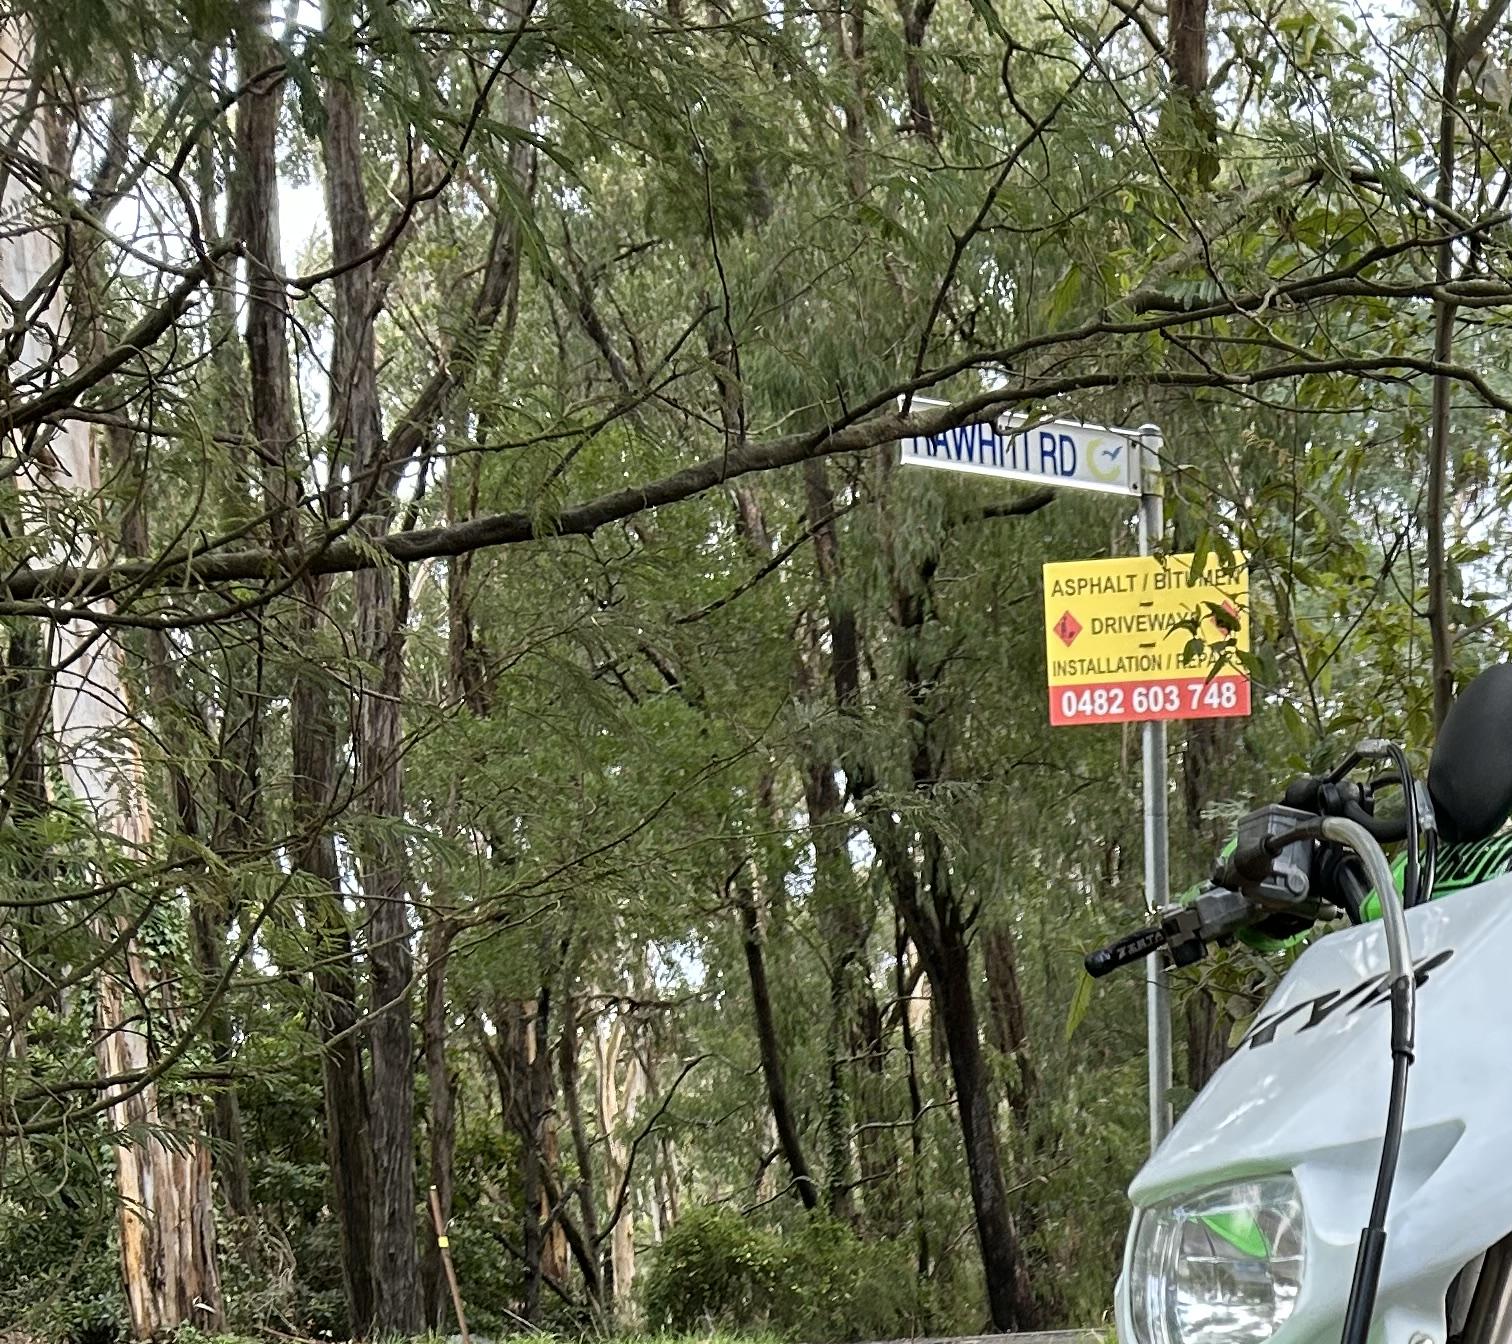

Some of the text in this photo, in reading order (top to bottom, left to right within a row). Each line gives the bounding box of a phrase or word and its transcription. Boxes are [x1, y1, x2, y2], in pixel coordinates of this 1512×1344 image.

[1040, 431, 1077, 477] RD
[1050, 574, 1137, 597] ASPHALT
[1091, 611, 1199, 635] DRIVEWAY
[1053, 653, 1162, 677] INSTALLATION
[1061, 681, 1237, 718] 0482 603 748
